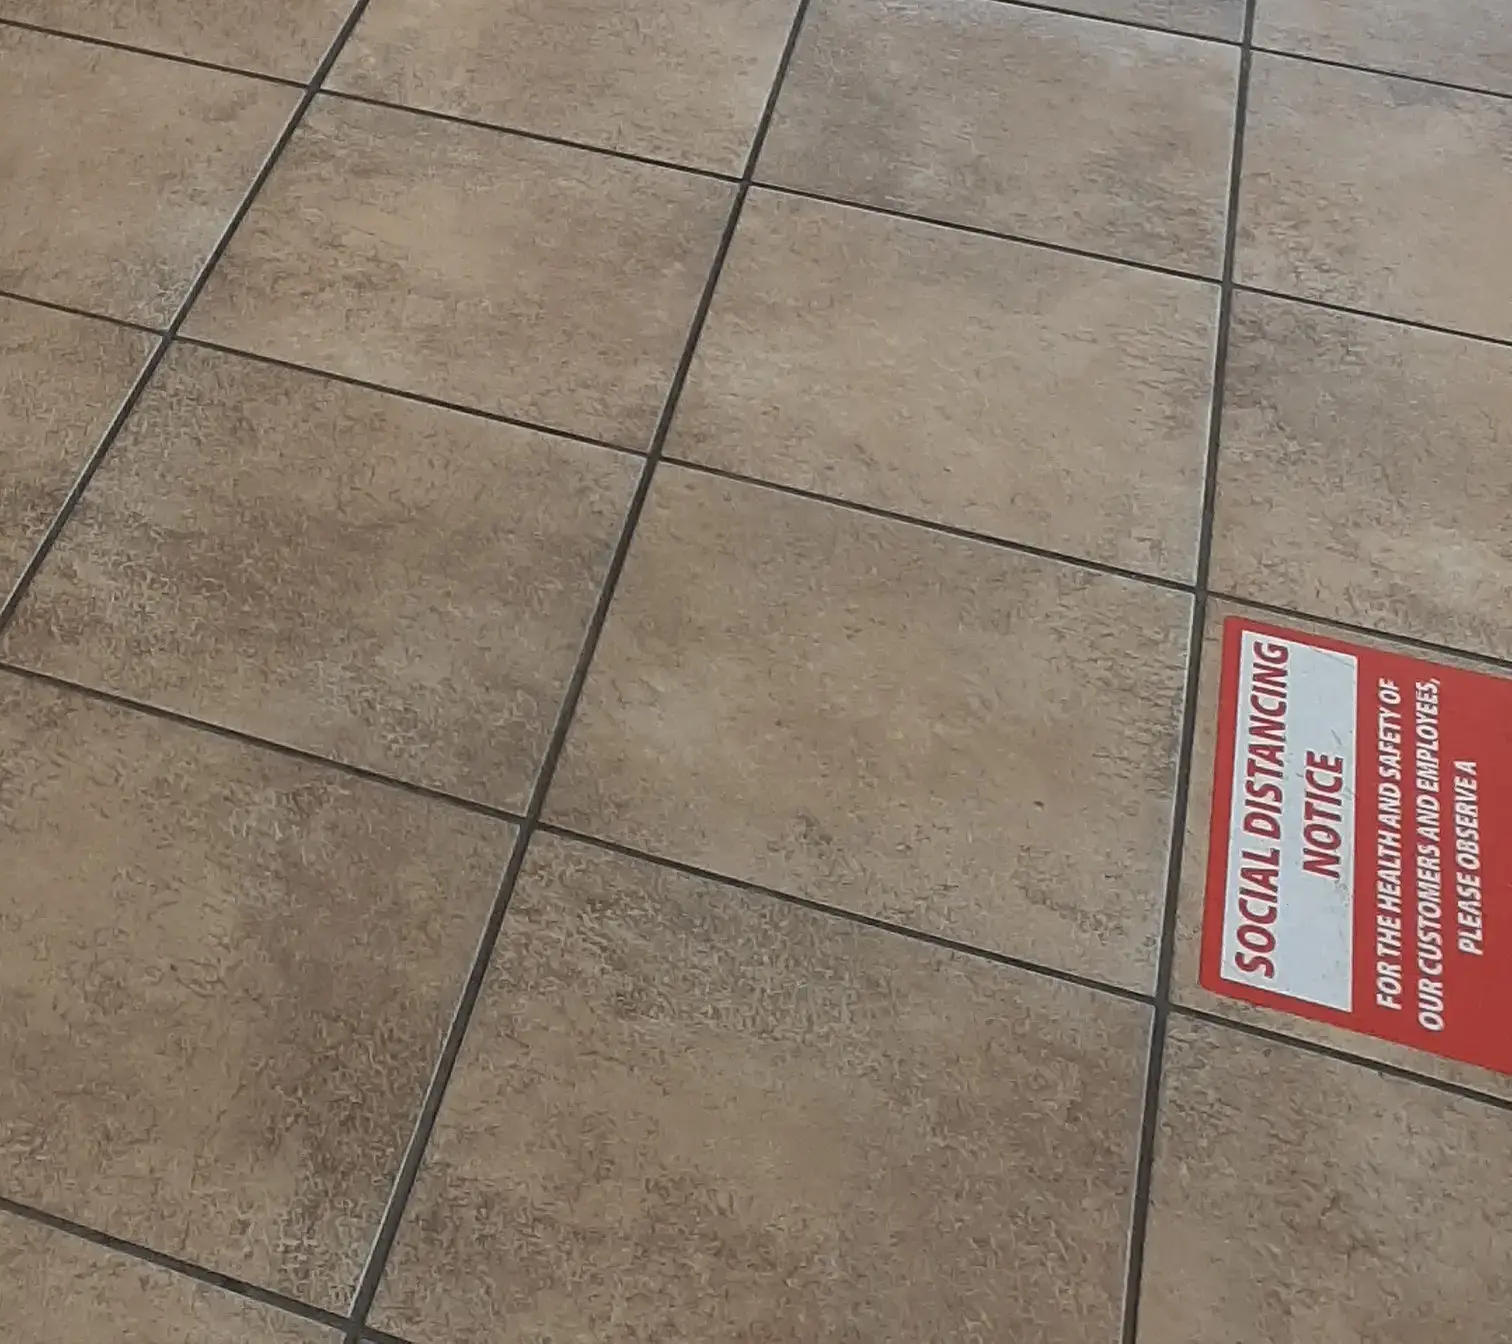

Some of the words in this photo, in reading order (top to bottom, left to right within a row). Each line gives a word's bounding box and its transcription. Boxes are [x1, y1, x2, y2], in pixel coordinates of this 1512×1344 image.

[1378, 678, 1400, 705] OF
[1242, 640, 1289, 840] DISTANCING
[1377, 706, 1402, 780] SAFETY
[1415, 677, 1441, 793] EMPLOYEES,
[1452, 761, 1477, 776] A
[1302, 750, 1344, 879] NOTICE
[1377, 784, 1402, 829] AND
[1416, 794, 1441, 842] AND
[1453, 777, 1480, 871] OBSERVE
[1377, 831, 1402, 913] HEALTH
[1416, 844, 1443, 976] CUSTOMERS
[1235, 848, 1281, 979] SOCIAL
[1377, 916, 1402, 958] THE
[1455, 872, 1484, 956] PLEASE
[1377, 962, 1402, 1010] FOR
[1418, 977, 1445, 1031] OUR
